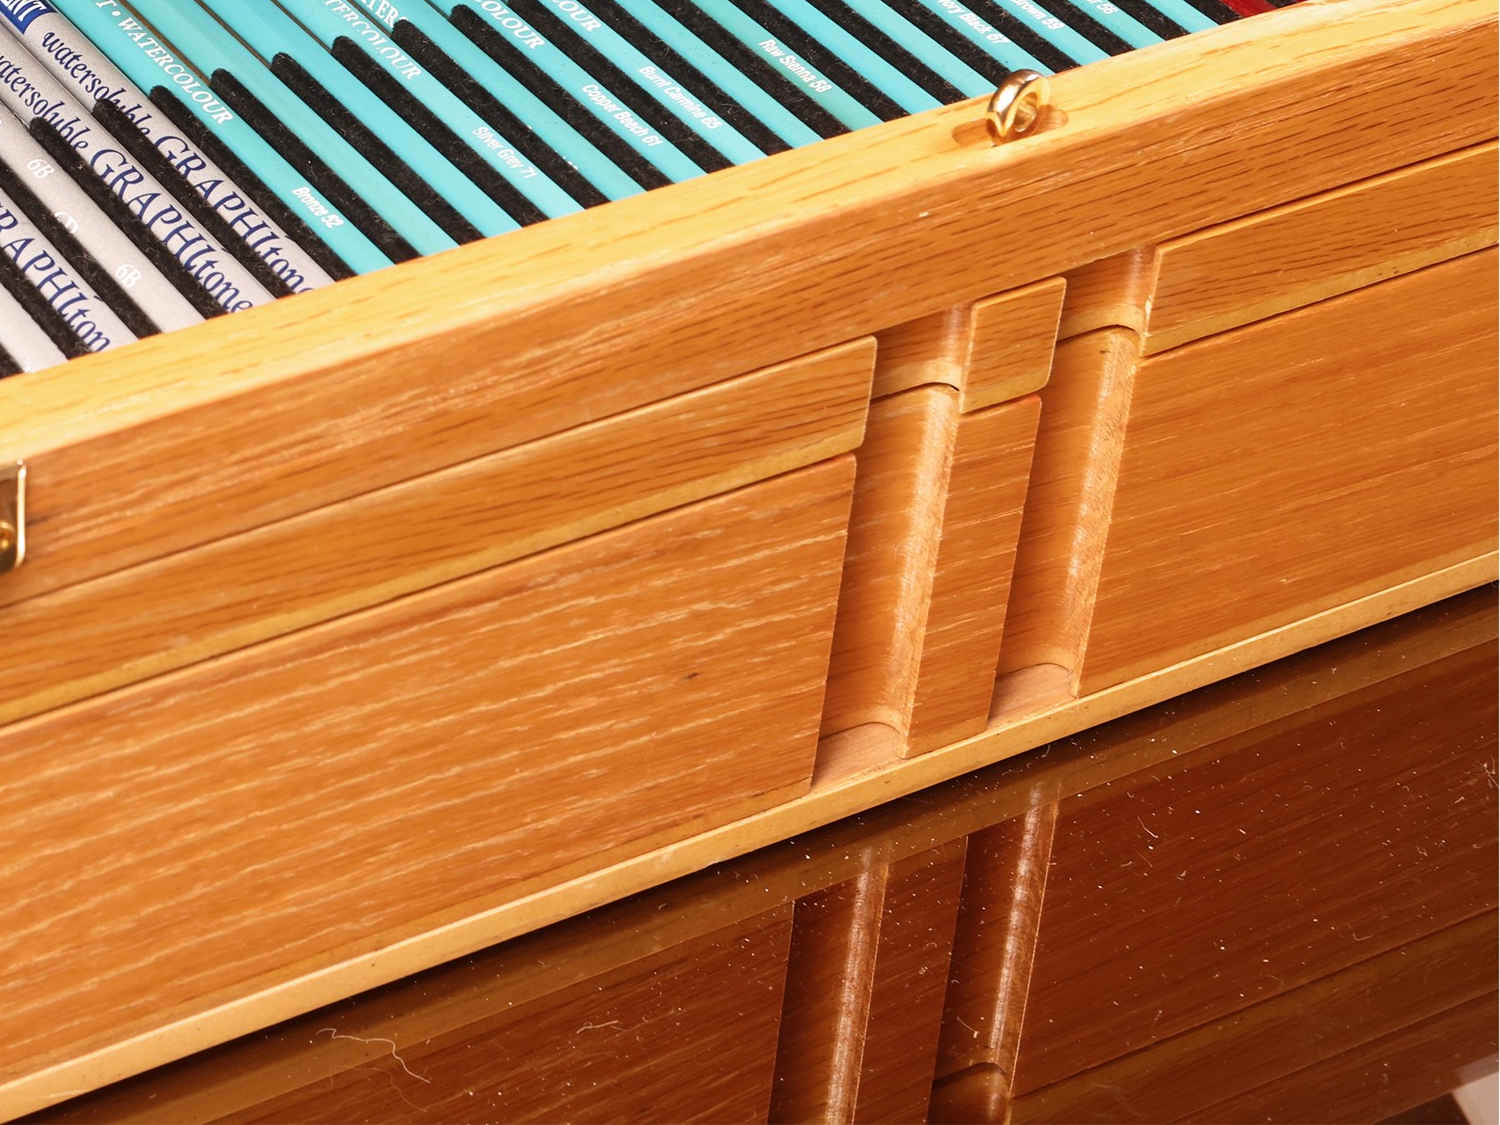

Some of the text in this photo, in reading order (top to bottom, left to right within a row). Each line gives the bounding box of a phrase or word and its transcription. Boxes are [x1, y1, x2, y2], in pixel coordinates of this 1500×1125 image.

[959, 11, 992, 35] Black
[117, 17, 234, 125] WATERCOLOUR
[758, 39, 816, 83] Raw Sienna
[638, 66, 710, 120] Burnt Carmine
[582, 84, 663, 148] Copper Beech 61
[27, 158, 55, 180] 6B
[472, 127, 498, 150] Silver
[500, 148, 525, 173] Grey
[292, 186, 325, 219] Bronze
[116, 263, 143, 289] 6B
